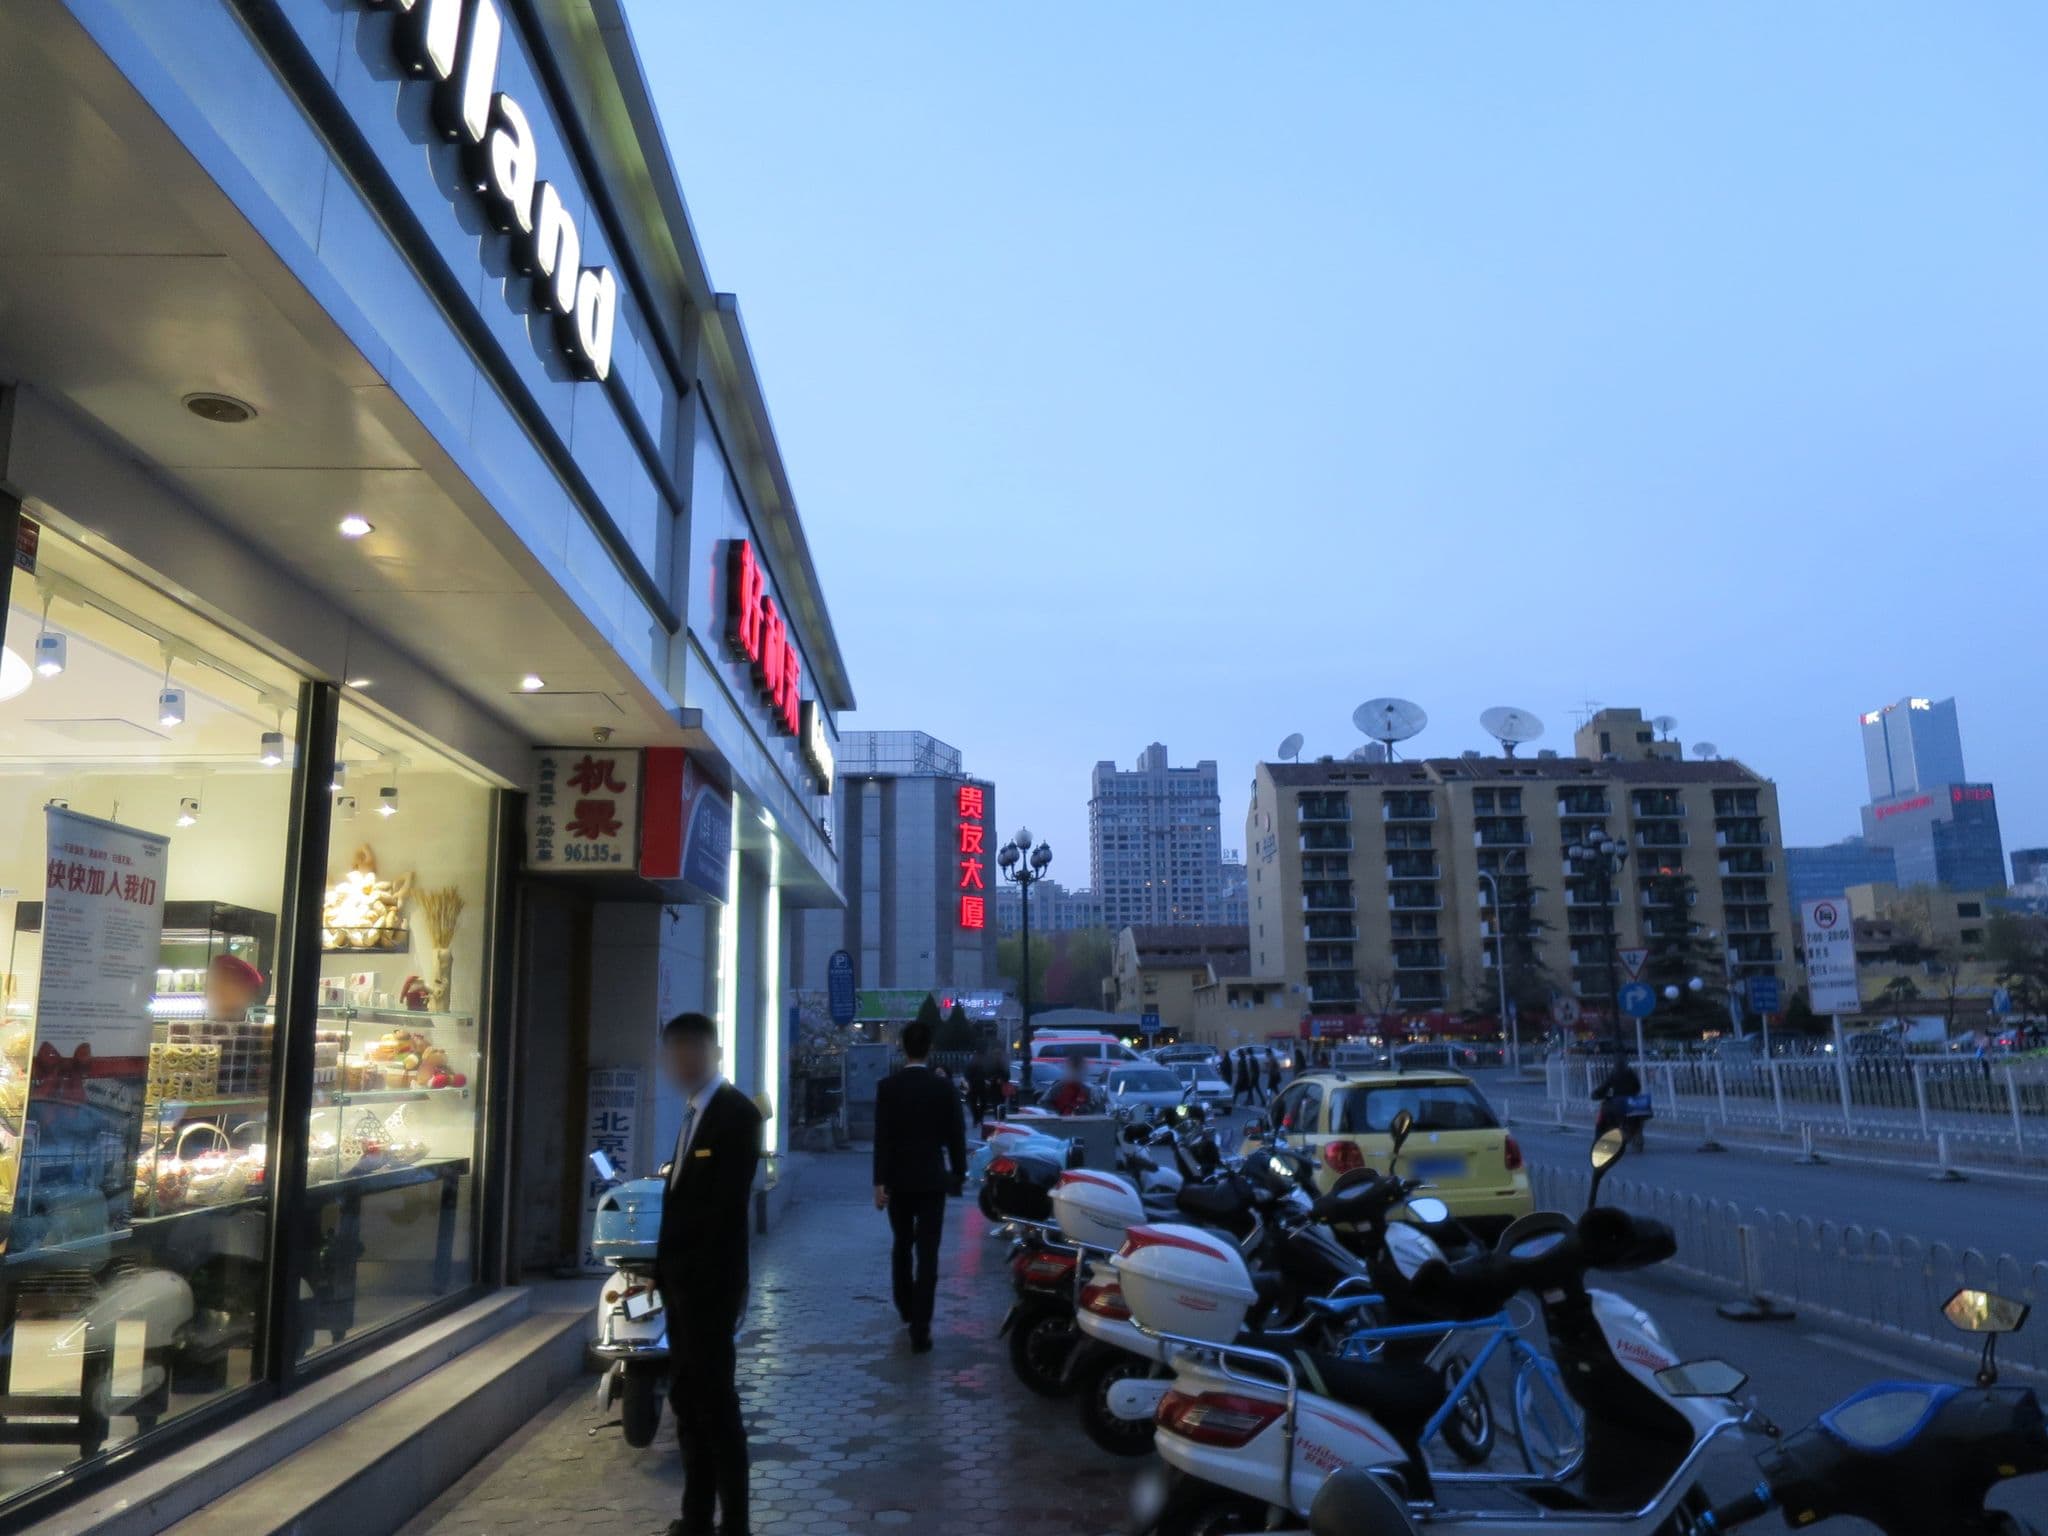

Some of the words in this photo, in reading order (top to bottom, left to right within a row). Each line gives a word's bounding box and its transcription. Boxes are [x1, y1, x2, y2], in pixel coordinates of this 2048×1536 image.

[565, 754, 627, 841] 机票
[564, 843, 609, 862] 96135
[959, 786, 985, 929] 贵友大厦
